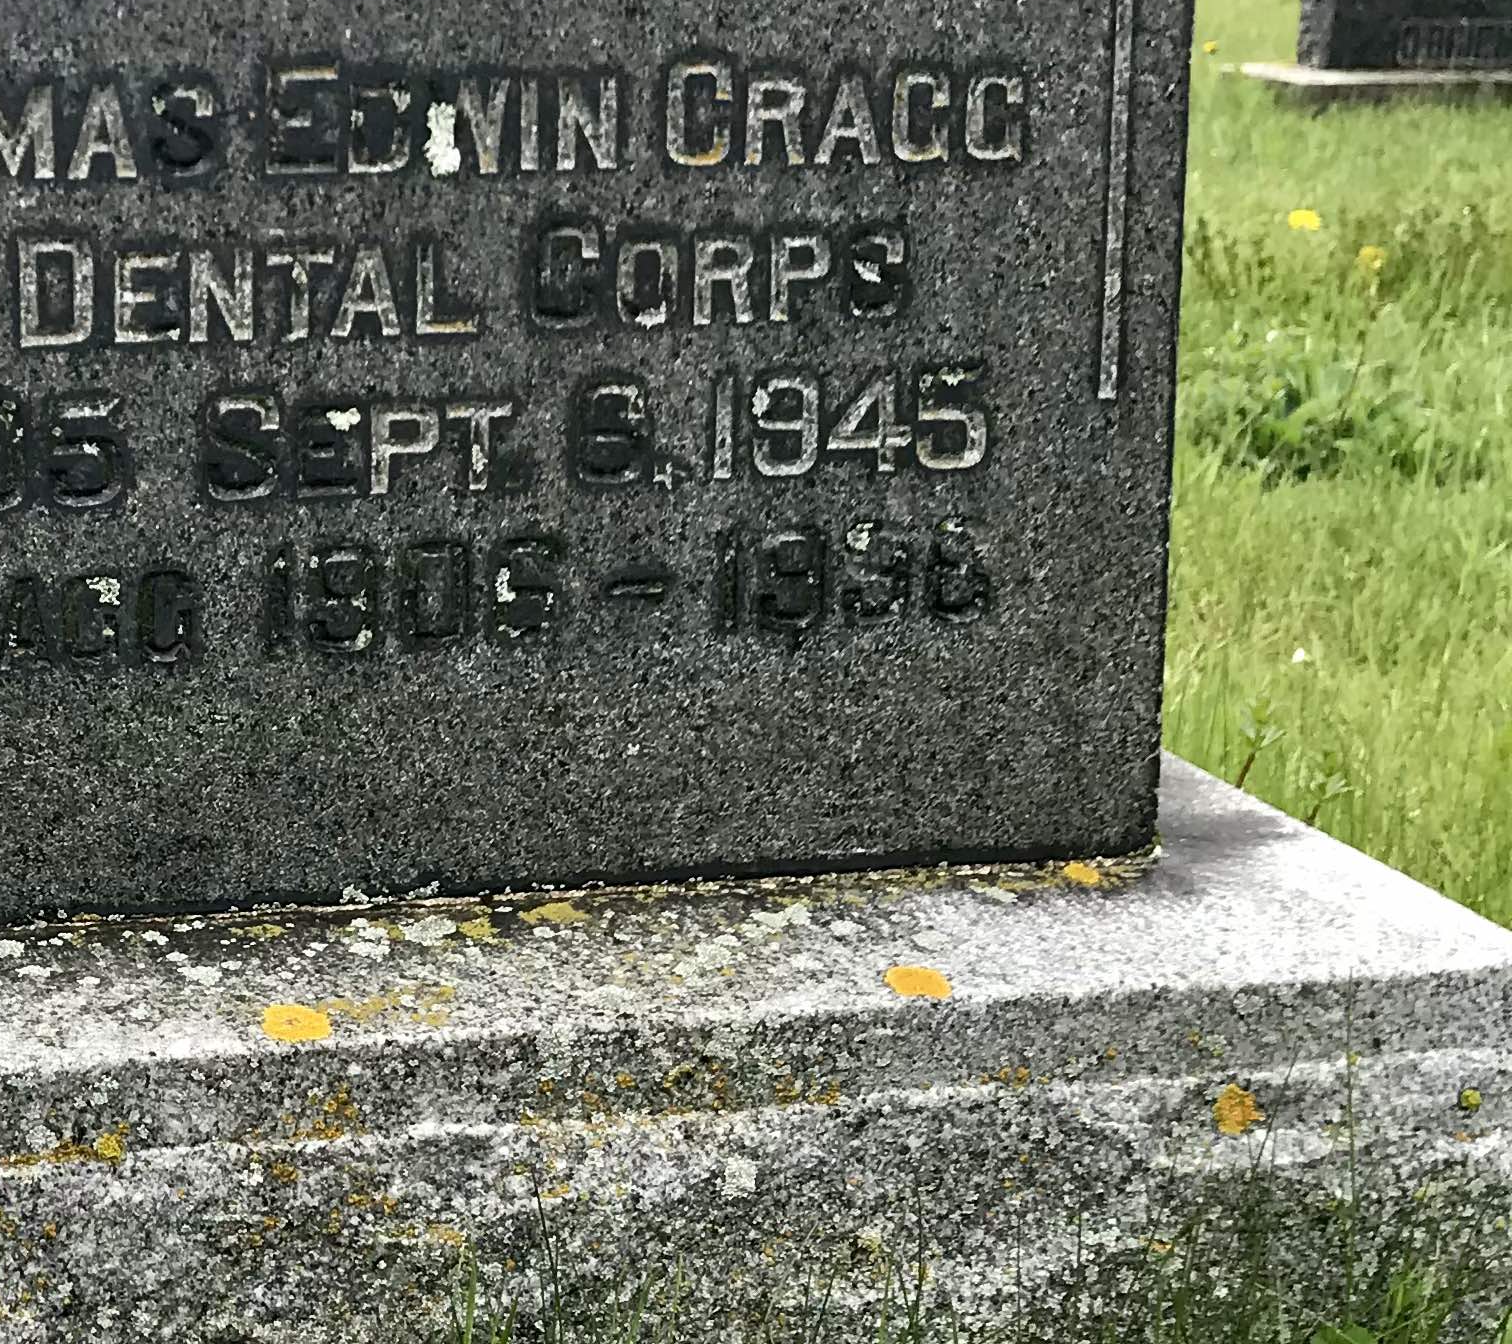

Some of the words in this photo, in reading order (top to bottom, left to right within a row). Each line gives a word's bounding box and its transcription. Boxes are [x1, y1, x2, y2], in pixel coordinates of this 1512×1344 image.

[265, 64, 620, 177] EDWIN
[665, 59, 1025, 167] CRAGG
[18, 236, 478, 349] DENTAL
[530, 224, 906, 329] CORPS
[712, 366, 990, 482] 1945
